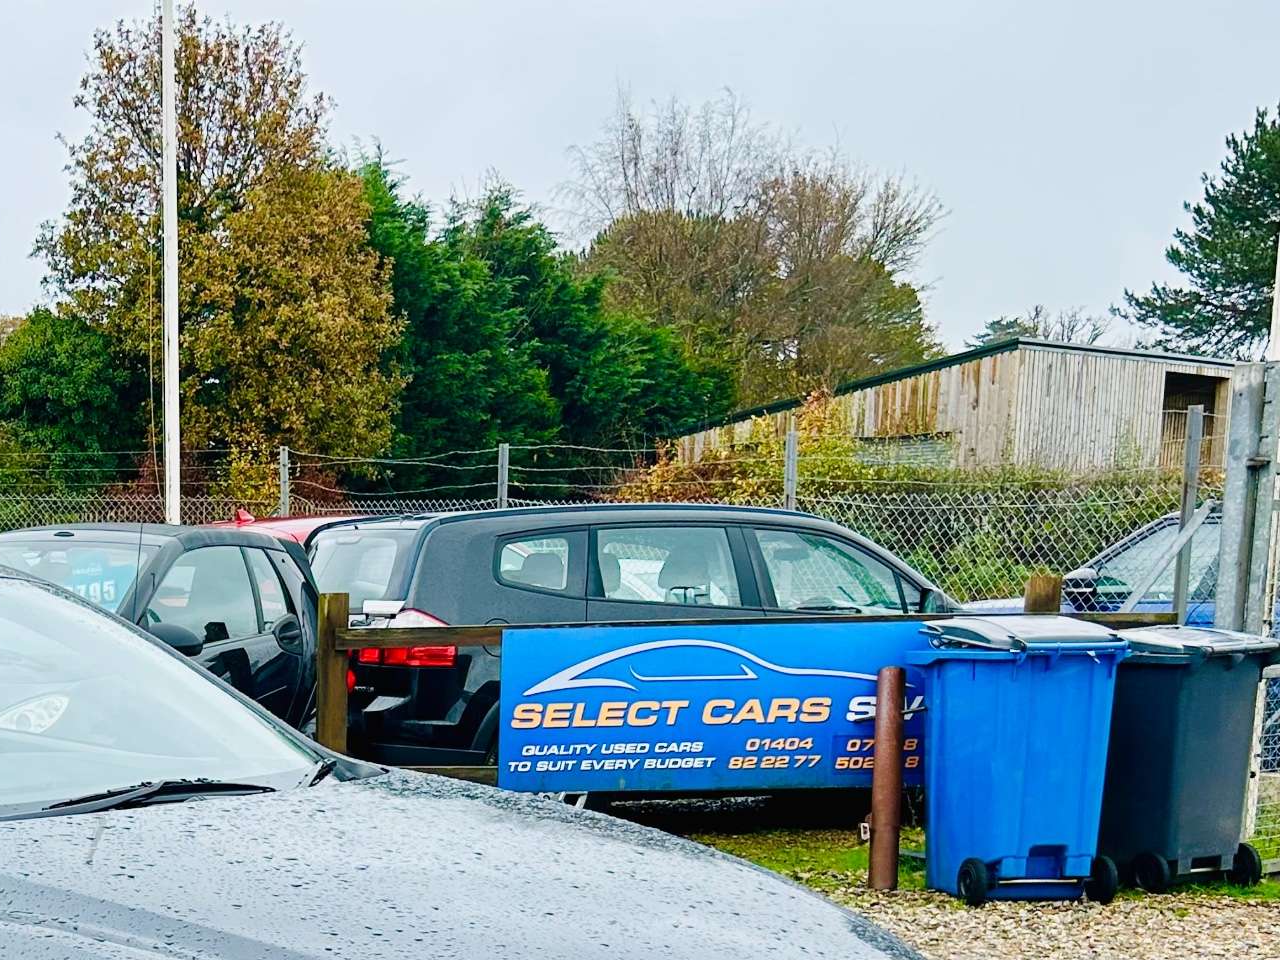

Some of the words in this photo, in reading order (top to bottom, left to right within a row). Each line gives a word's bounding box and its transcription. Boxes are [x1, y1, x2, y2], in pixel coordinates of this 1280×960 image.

[511, 700, 689, 728] SELECT
[703, 697, 832, 725] CARS
[522, 744, 597, 756] QUALITY
[601, 743, 649, 755] USED
[654, 742, 704, 753] CARS
[745, 737, 814, 751] 01404
[508, 761, 532, 772] TO
[536, 760, 576, 772] SUIT
[580, 758, 640, 771] EVERY
[644, 757, 716, 769] BUDGET
[728, 756, 758, 769] 82
[760, 755, 790, 769] 22
[793, 754, 822, 768] 77
